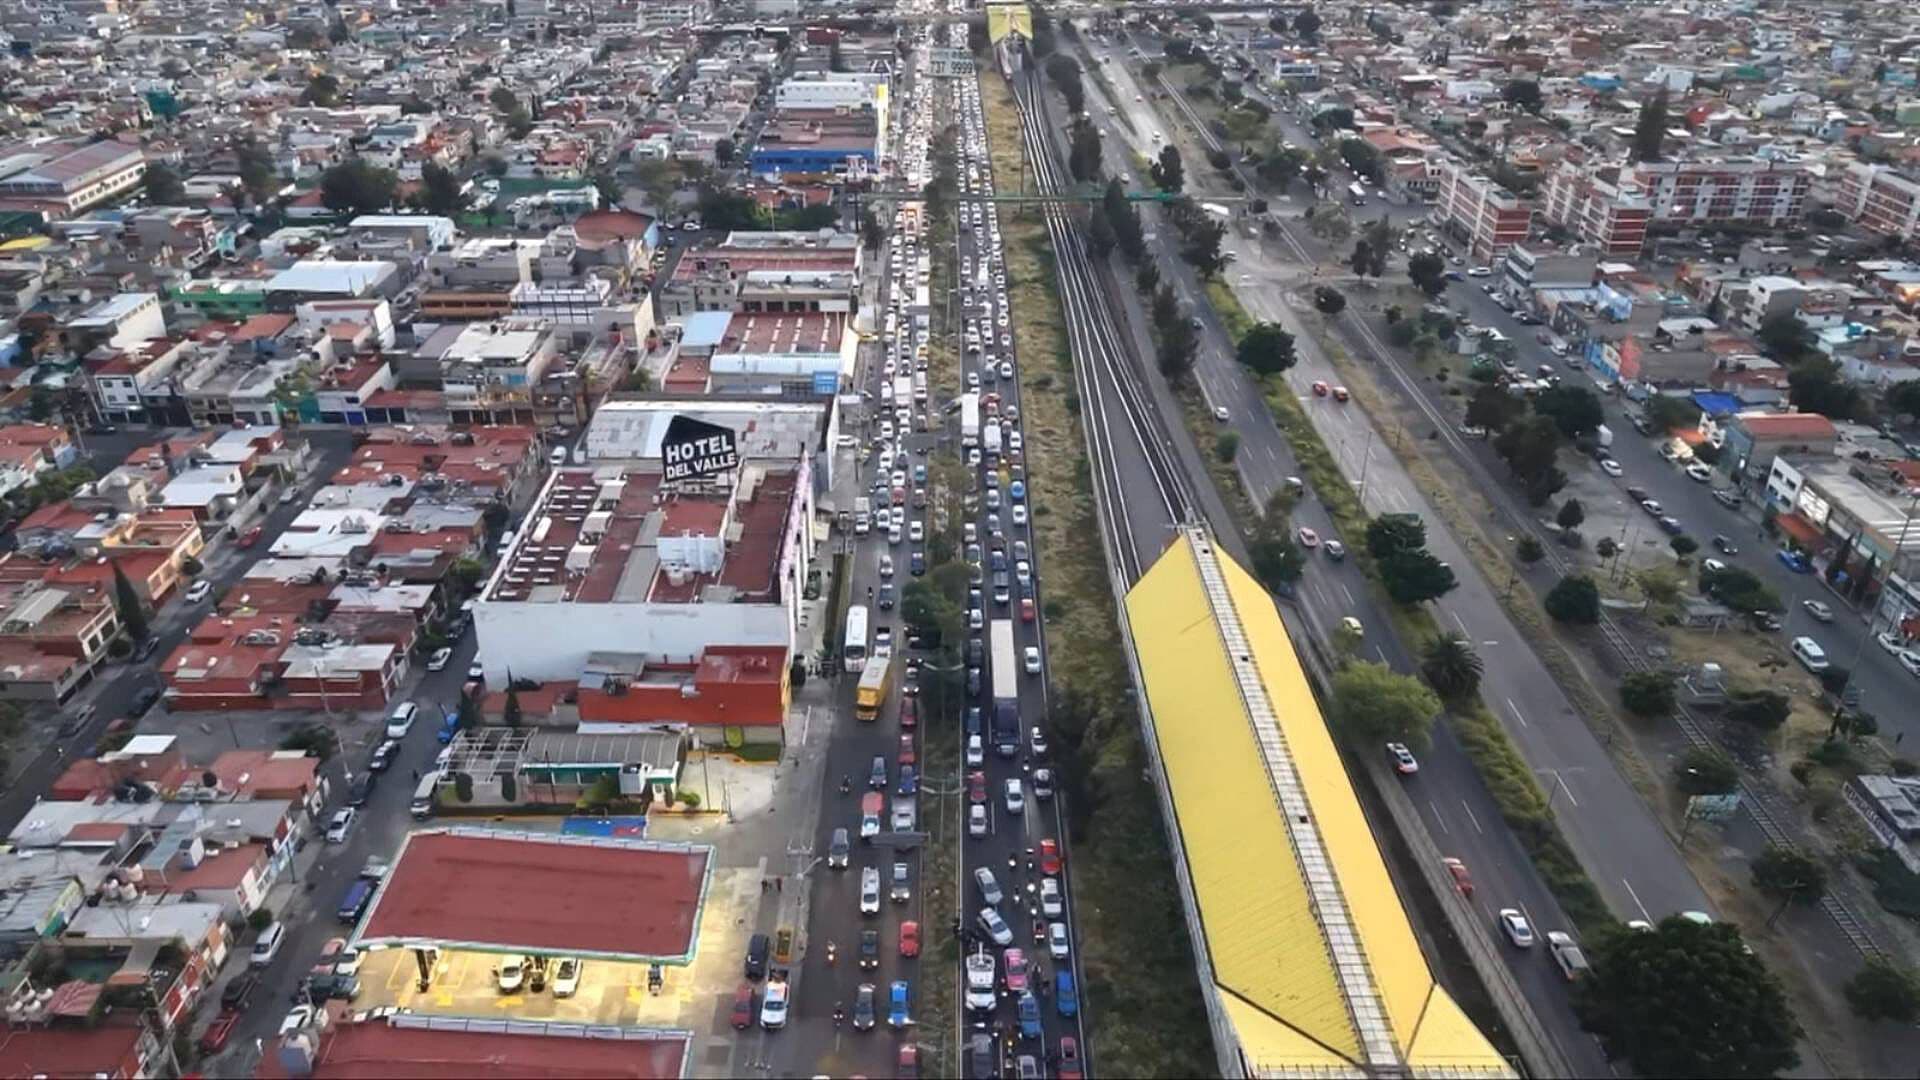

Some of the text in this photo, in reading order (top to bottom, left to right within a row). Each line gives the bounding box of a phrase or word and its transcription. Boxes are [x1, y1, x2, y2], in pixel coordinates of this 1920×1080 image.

[666, 435, 733, 464] HOTEL
[666, 452, 737, 480] DEL VALLE
